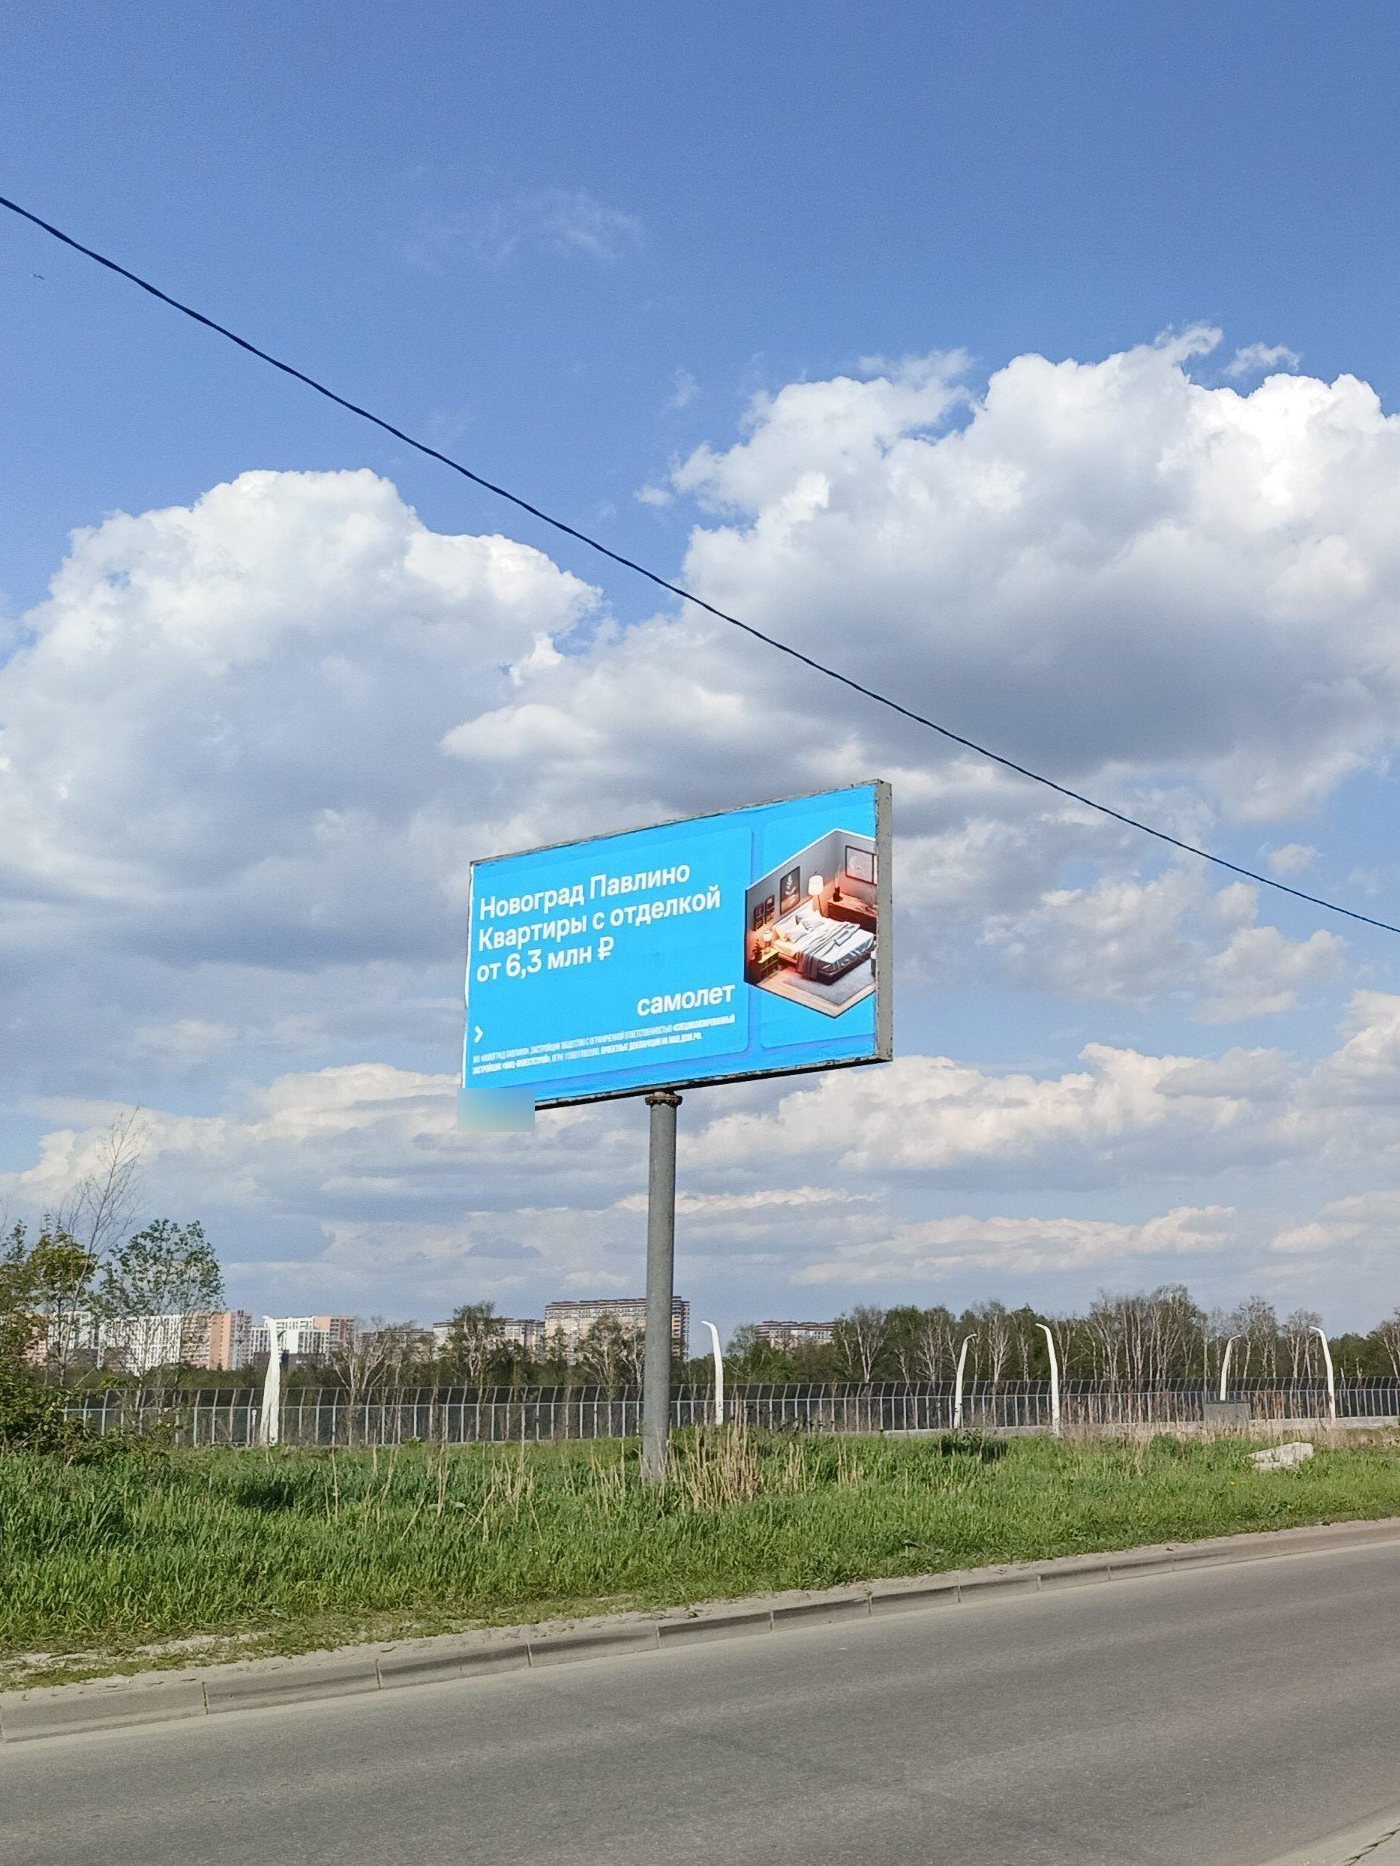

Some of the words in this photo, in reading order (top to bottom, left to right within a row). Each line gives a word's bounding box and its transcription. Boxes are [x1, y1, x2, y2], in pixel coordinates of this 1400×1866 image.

[480, 884, 585, 920] Новоград
[589, 864, 690, 899] Павлино
[478, 914, 588, 952] Квартиры
[592, 911, 606, 931] с
[610, 884, 721, 927] отделкой
[476, 960, 501, 983] от
[505, 948, 542, 980] 6,3
[547, 945, 593, 970] млн
[598, 936, 615, 961] ₽
[637, 984, 736, 1016] самолет
